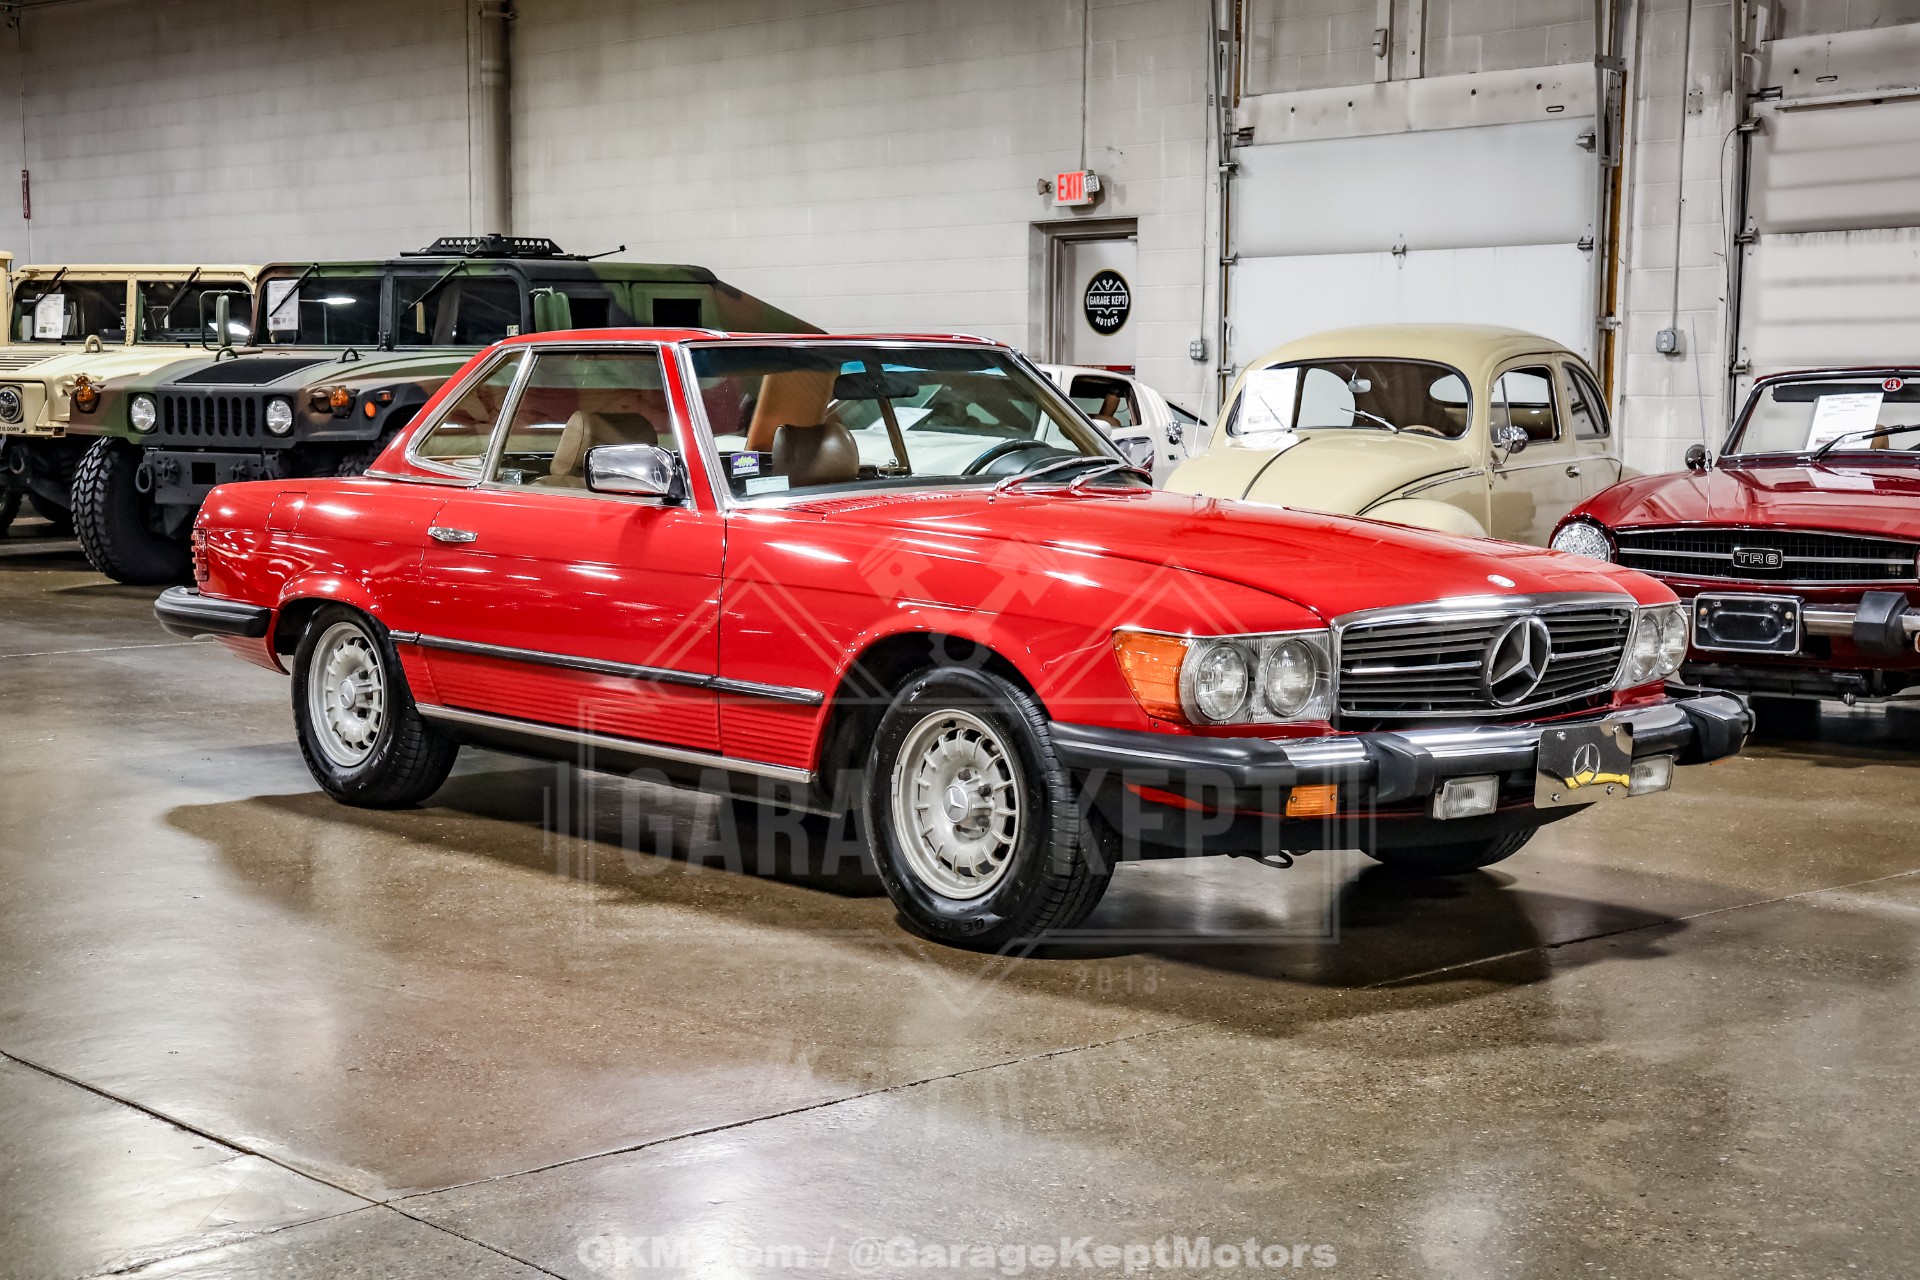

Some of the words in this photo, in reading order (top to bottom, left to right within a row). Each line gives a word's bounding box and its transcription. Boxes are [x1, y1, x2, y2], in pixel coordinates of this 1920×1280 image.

[1057, 172, 1084, 201] EXIT
[1089, 295, 1110, 305] GARAGE
[1111, 295, 1126, 305] KEPT
[1095, 315, 1119, 327] MOTORS
